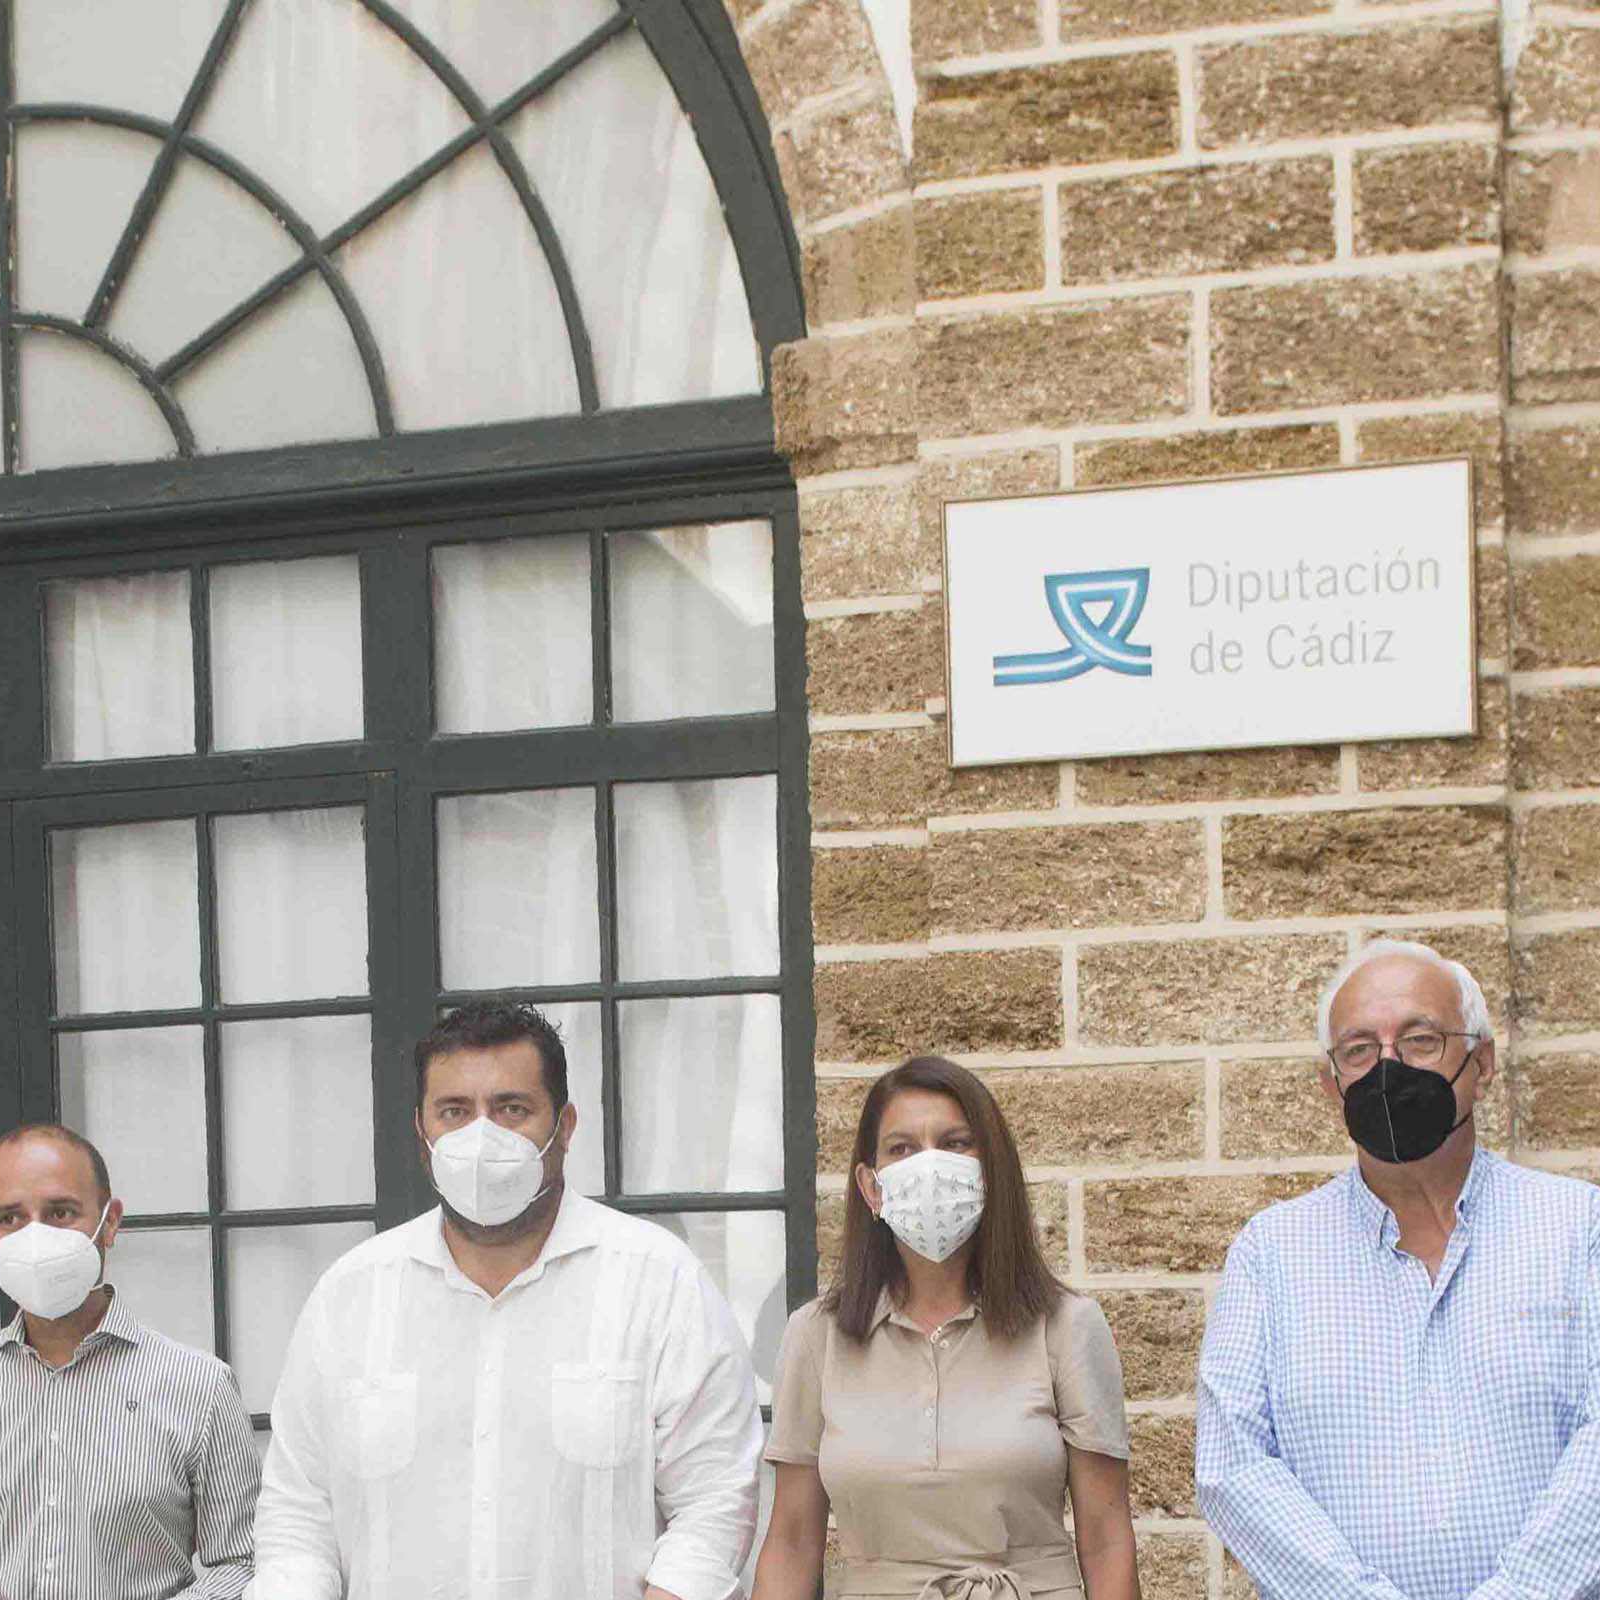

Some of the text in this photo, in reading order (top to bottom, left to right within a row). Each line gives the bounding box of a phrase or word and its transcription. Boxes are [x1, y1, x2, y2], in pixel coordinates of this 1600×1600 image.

[1187, 546, 1441, 613] Diputación
[1189, 621, 1396, 675] de Cádiz
